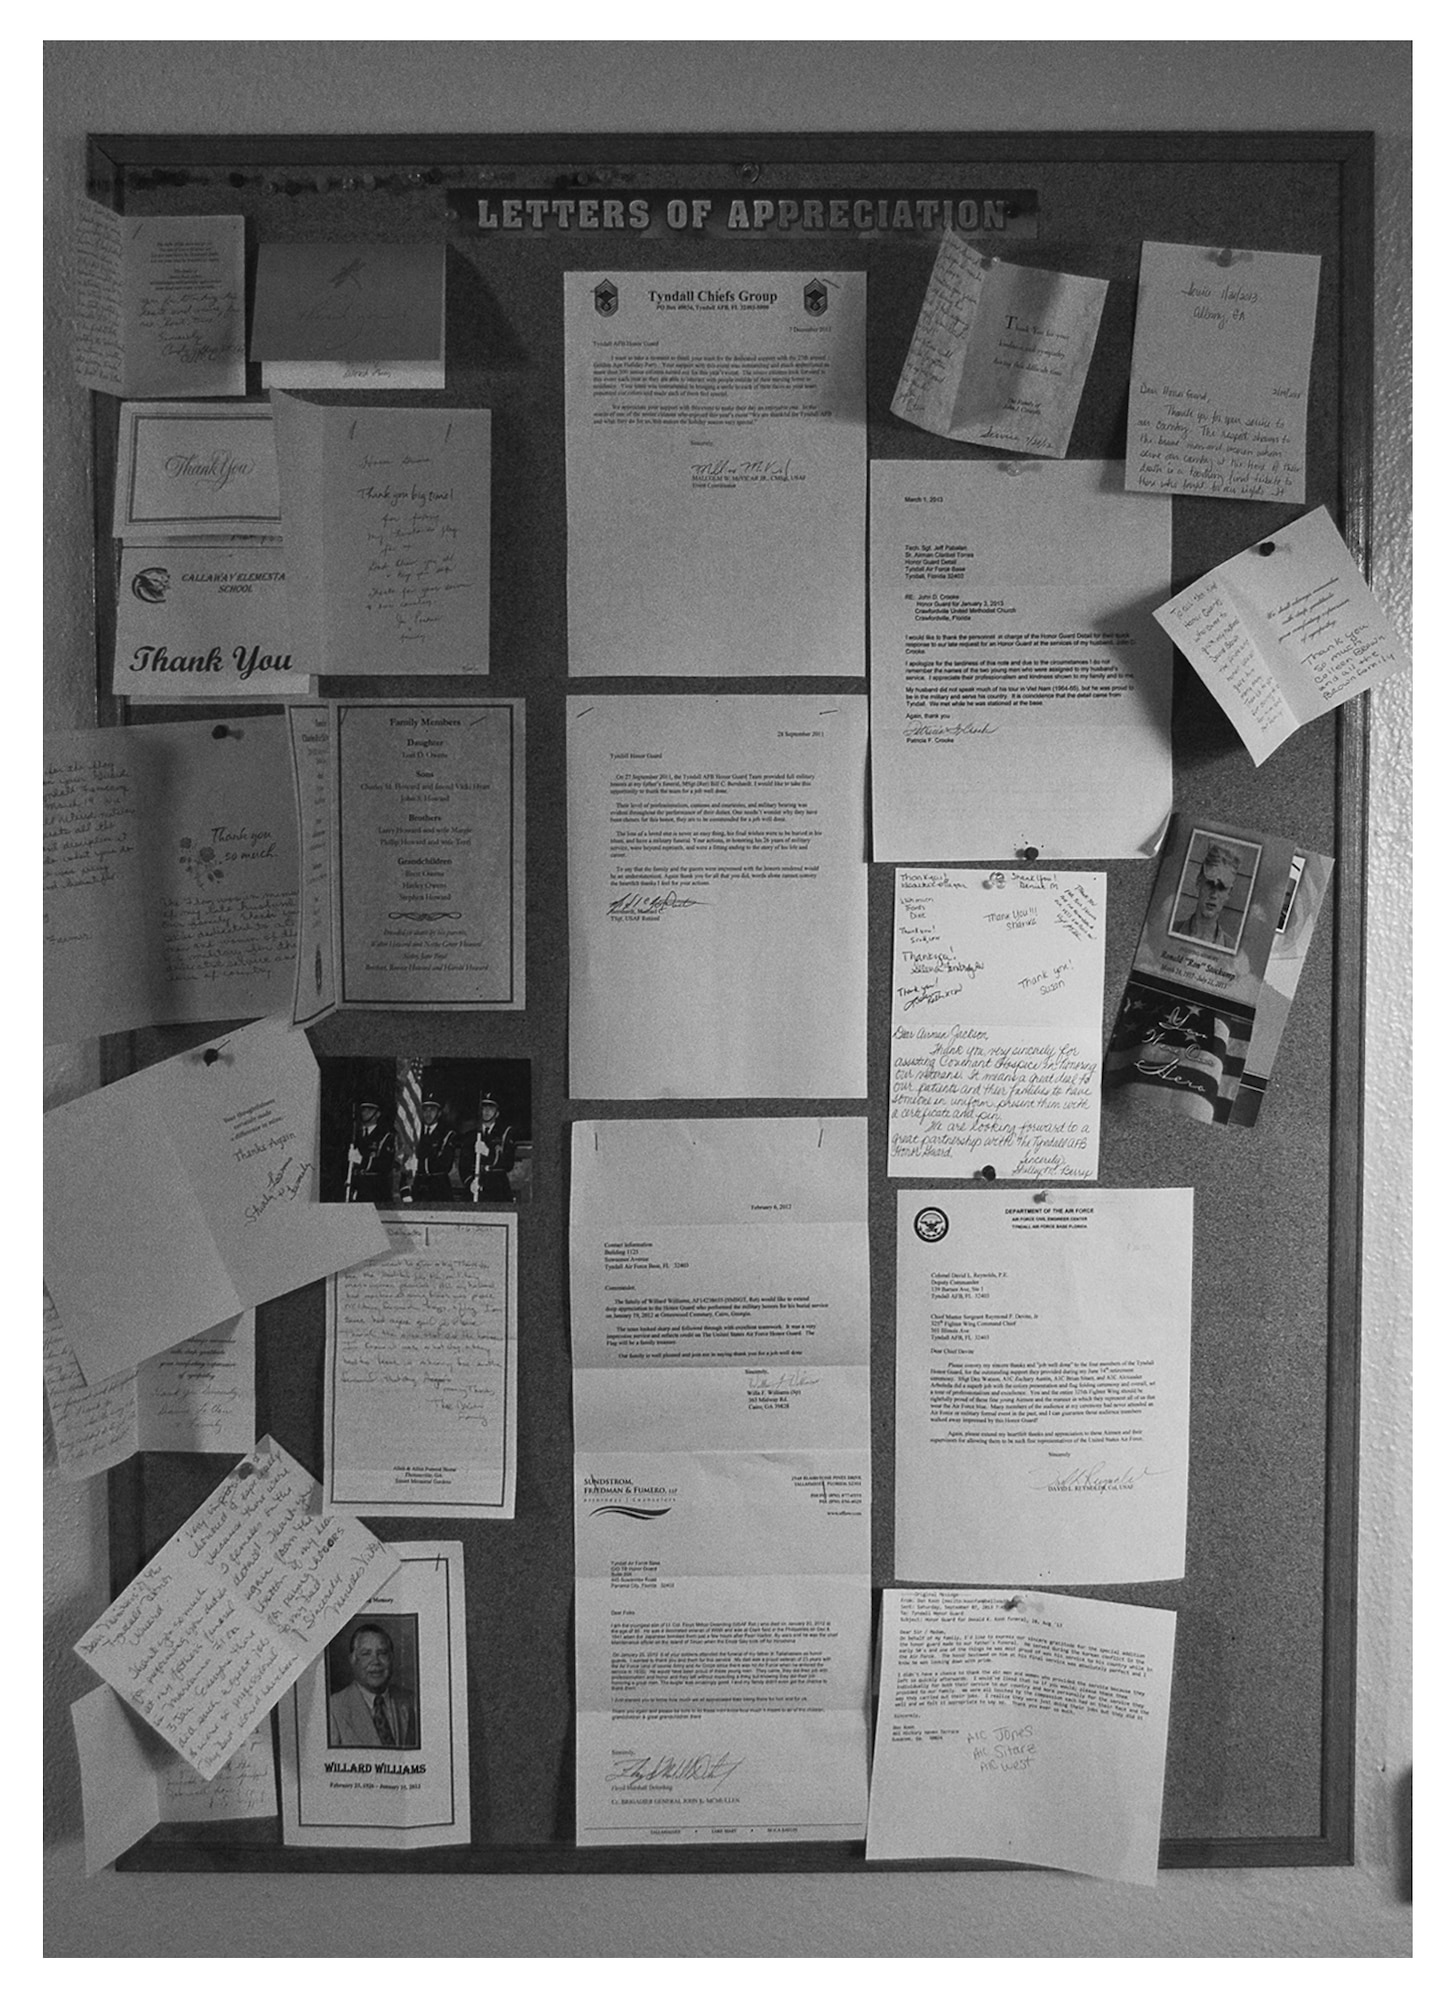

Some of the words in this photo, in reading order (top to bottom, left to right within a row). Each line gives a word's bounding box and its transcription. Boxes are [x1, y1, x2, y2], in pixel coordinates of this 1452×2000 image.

[477, 199, 651, 229] LETTERS
[666, 199, 712, 229] OF
[726, 199, 1005, 230] APPRECIATION
[648, 290, 694, 304] Tyndall
[697, 290, 735, 302] Chiefs
[738, 291, 778, 304] Group
[165, 453, 216, 479] Thank
[214, 451, 256, 492] You
[905, 566, 924, 574] Tyndall
[951, 565, 966, 573] Base
[181, 572, 236, 583] CALLAWAY
[218, 584, 253, 594] SCHOOL
[916, 601, 933, 609] Honor
[996, 606, 1016, 614] Church
[1300, 638, 1344, 665] Thank
[129, 646, 223, 672] Thank
[233, 645, 292, 680] You
[389, 718, 418, 728] Family
[421, 718, 461, 726] Members
[407, 738, 444, 748] Daughter
[416, 770, 434, 778] Sons
[409, 814, 442, 822] Brothers
[211, 826, 247, 843] Thank
[251, 832, 271, 848] you
[225, 852, 238, 861] so
[397, 857, 452, 865] Grandchildren
[1018, 970, 1048, 989] Thank
[233, 1143, 267, 1162] Thanks
[268, 1133, 296, 1150] Again
[324, 1762, 372, 1773] WILLARD
[375, 1764, 426, 1775] WILLIAMS
